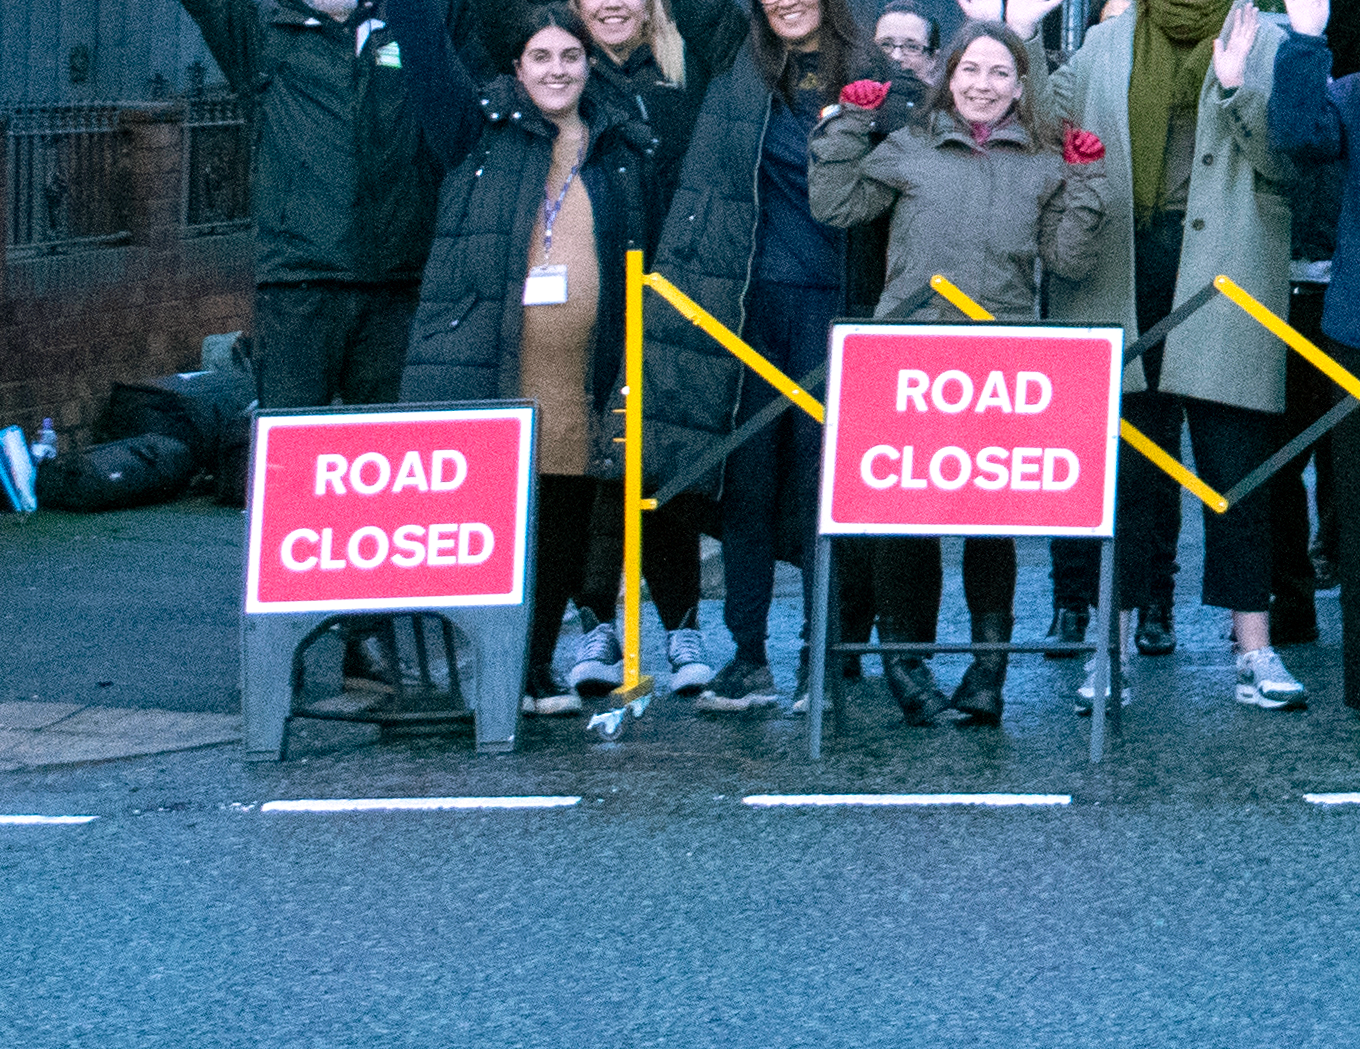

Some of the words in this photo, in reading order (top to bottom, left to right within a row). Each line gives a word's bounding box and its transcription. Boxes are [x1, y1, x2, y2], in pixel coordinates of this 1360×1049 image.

[895, 368, 1053, 415] ROAD
[314, 448, 468, 497] ROAD
[859, 443, 1081, 493] CLOSED
[279, 521, 496, 573] CLOSED
